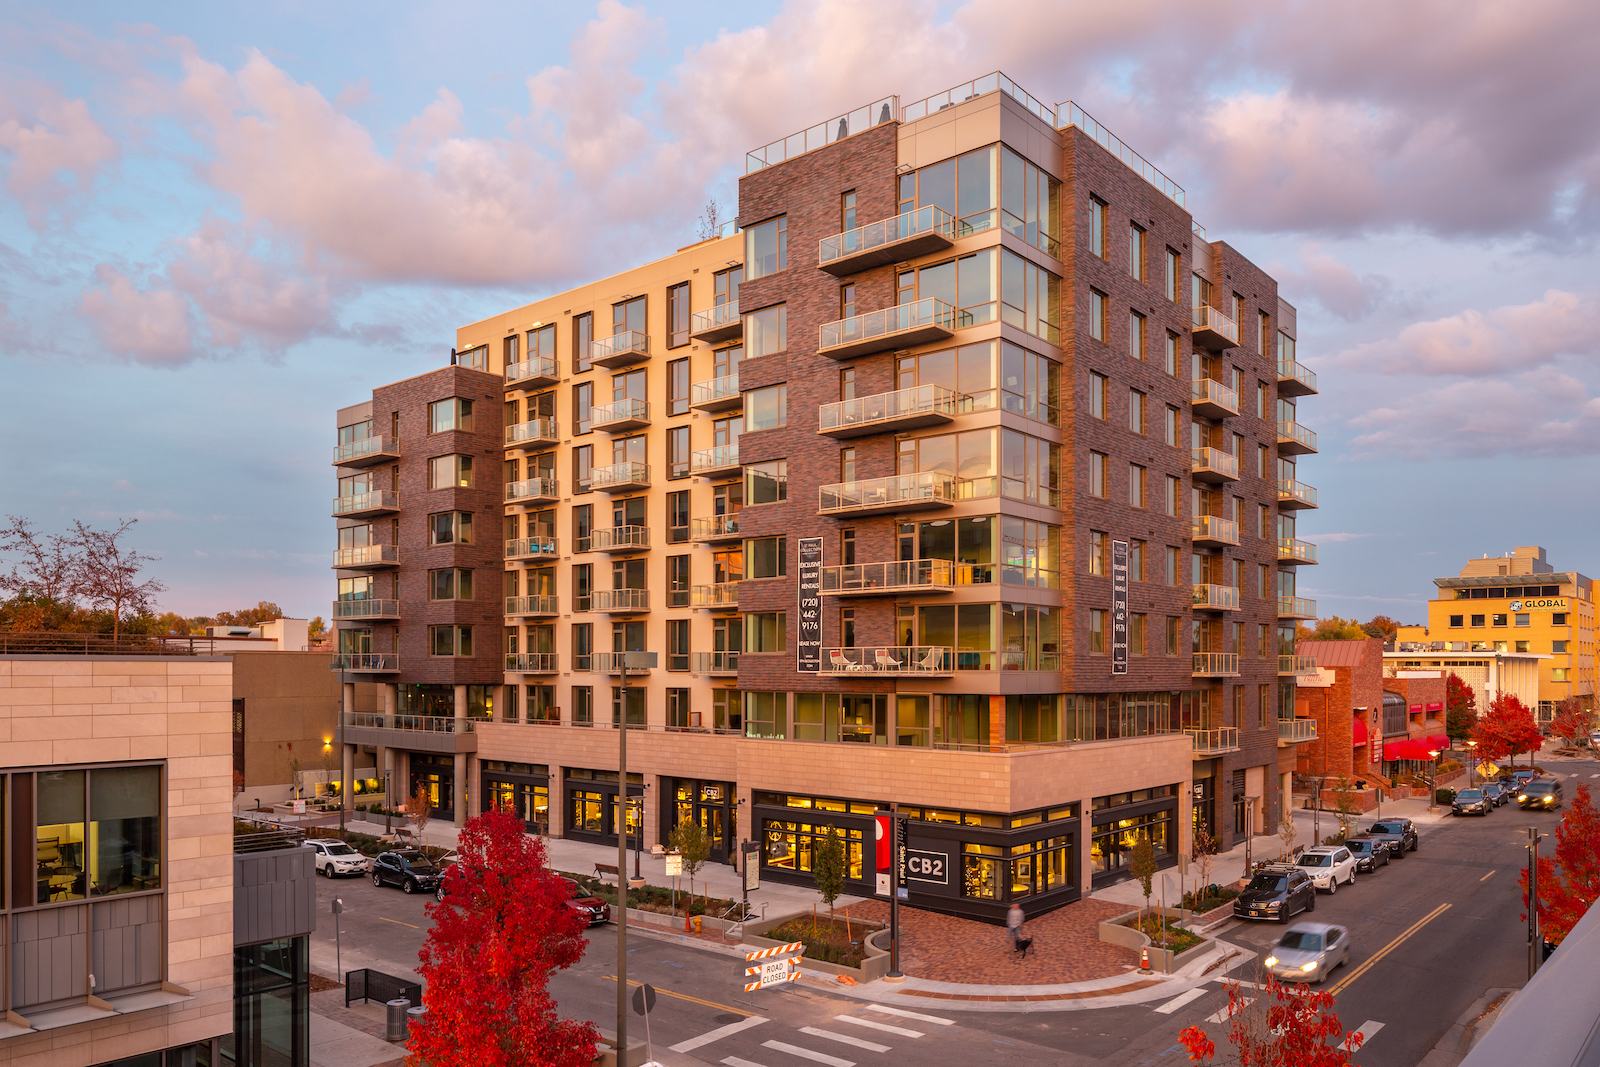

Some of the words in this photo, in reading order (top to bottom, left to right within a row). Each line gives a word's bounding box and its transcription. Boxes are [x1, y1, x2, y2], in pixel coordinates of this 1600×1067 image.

[801, 598, 818, 608] (720)
[1525, 599, 1566, 608] GLOBAL
[803, 610, 817, 618] 442-
[802, 622, 818, 630] 9176
[908, 856, 943, 876] CB2
[766, 963, 783, 974] ROAD
[762, 971, 787, 984] CLOSED
